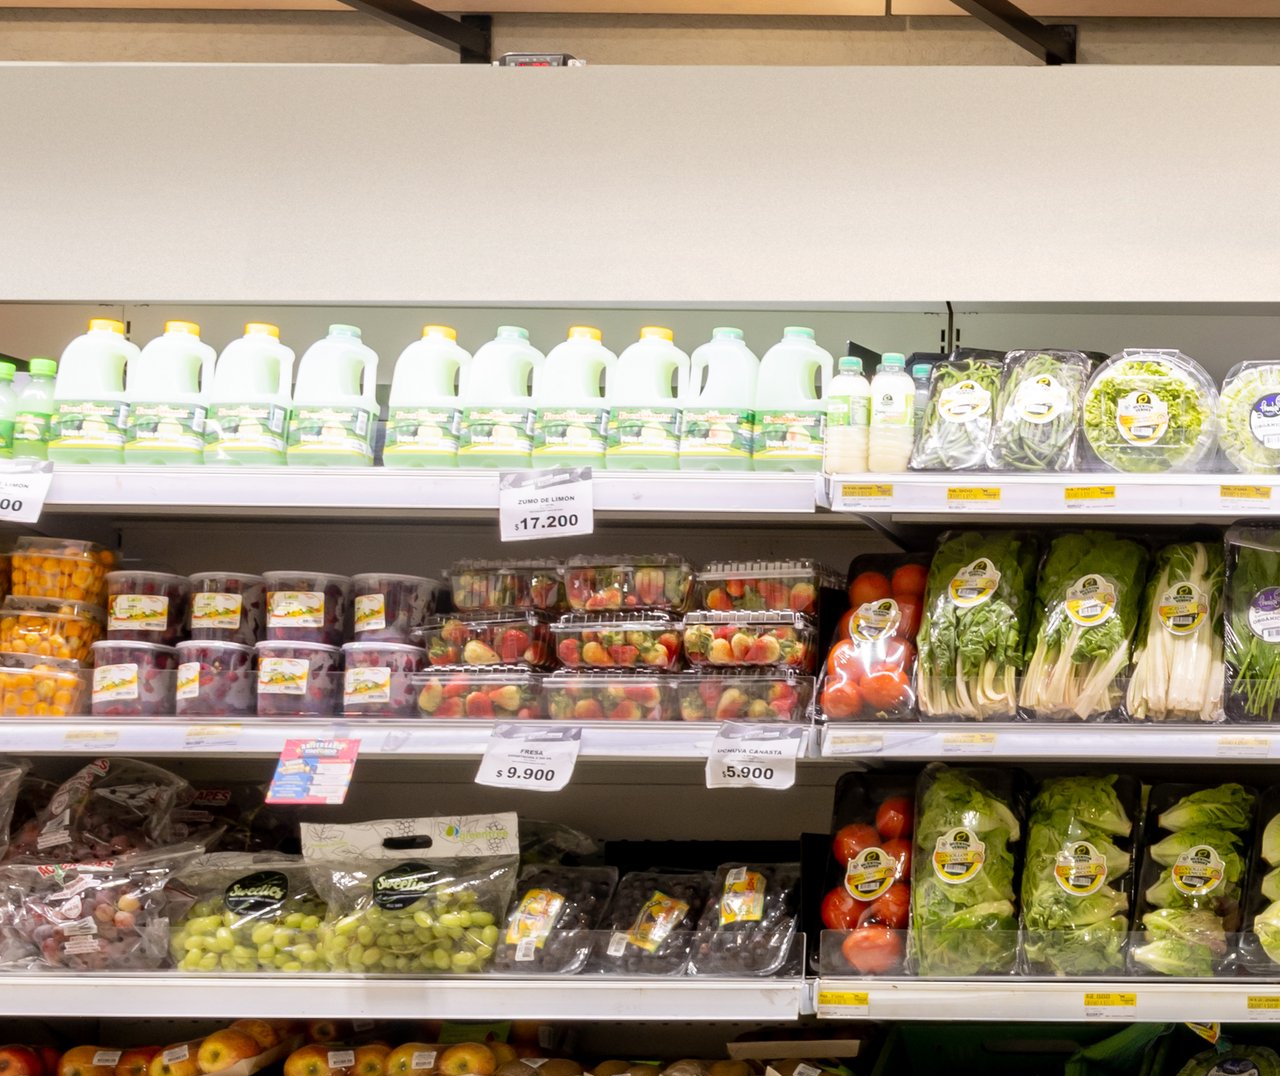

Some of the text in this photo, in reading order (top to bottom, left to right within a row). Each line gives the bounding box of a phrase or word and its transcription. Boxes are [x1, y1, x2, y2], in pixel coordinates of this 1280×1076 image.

[518, 497, 539, 505] ZUMO
[541, 496, 550, 504] DE
[520, 748, 544, 757] FRESA
[749, 748, 783, 756] CANASTA
[507, 766, 555, 781] 9.900
